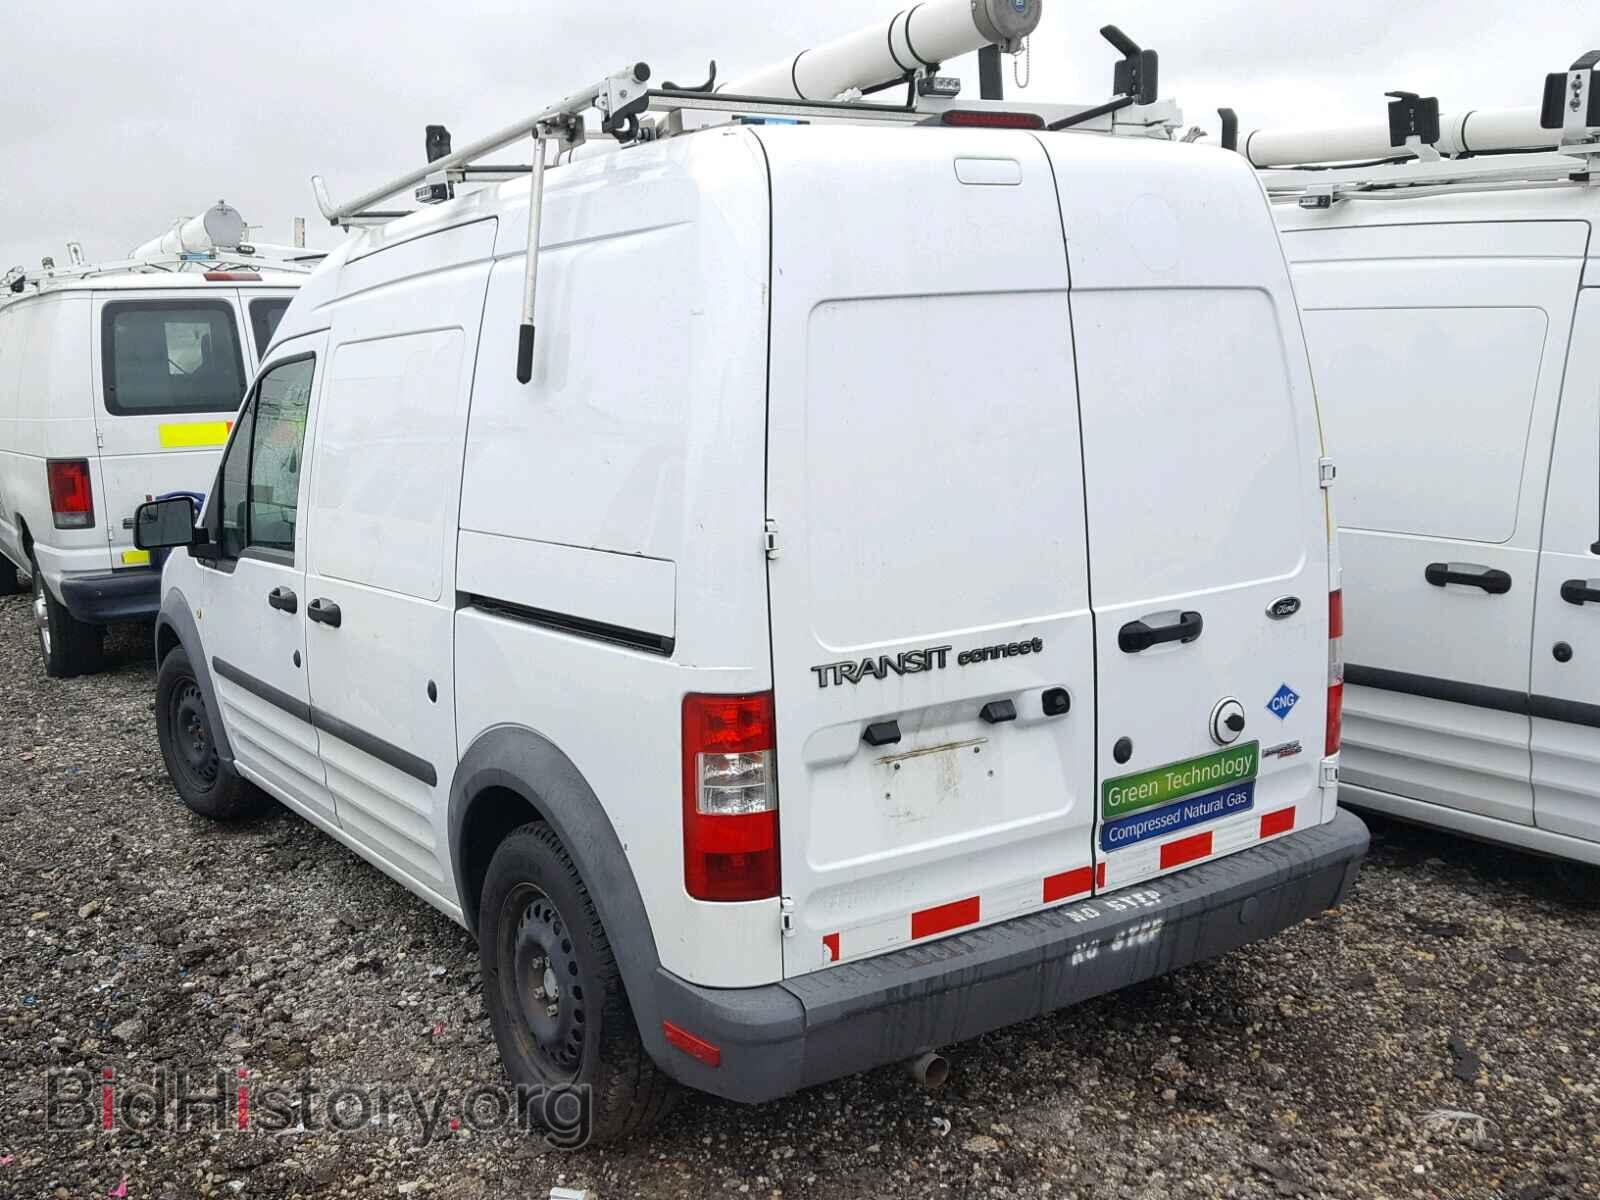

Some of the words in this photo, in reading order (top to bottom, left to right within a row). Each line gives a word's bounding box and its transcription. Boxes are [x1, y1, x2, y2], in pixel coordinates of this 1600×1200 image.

[811, 645, 952, 687] TRANSIT
[957, 636, 1043, 666] connect
[1271, 693, 1295, 711] CNG
[1108, 780, 1159, 807] Green
[1165, 753, 1253, 792] Technology
[1108, 809, 1181, 842] Compressed
[1183, 797, 1224, 820] Natural
[1226, 791, 1247, 807] Gas
[1065, 907, 1100, 922] NO
[1105, 889, 1161, 912] STEP
